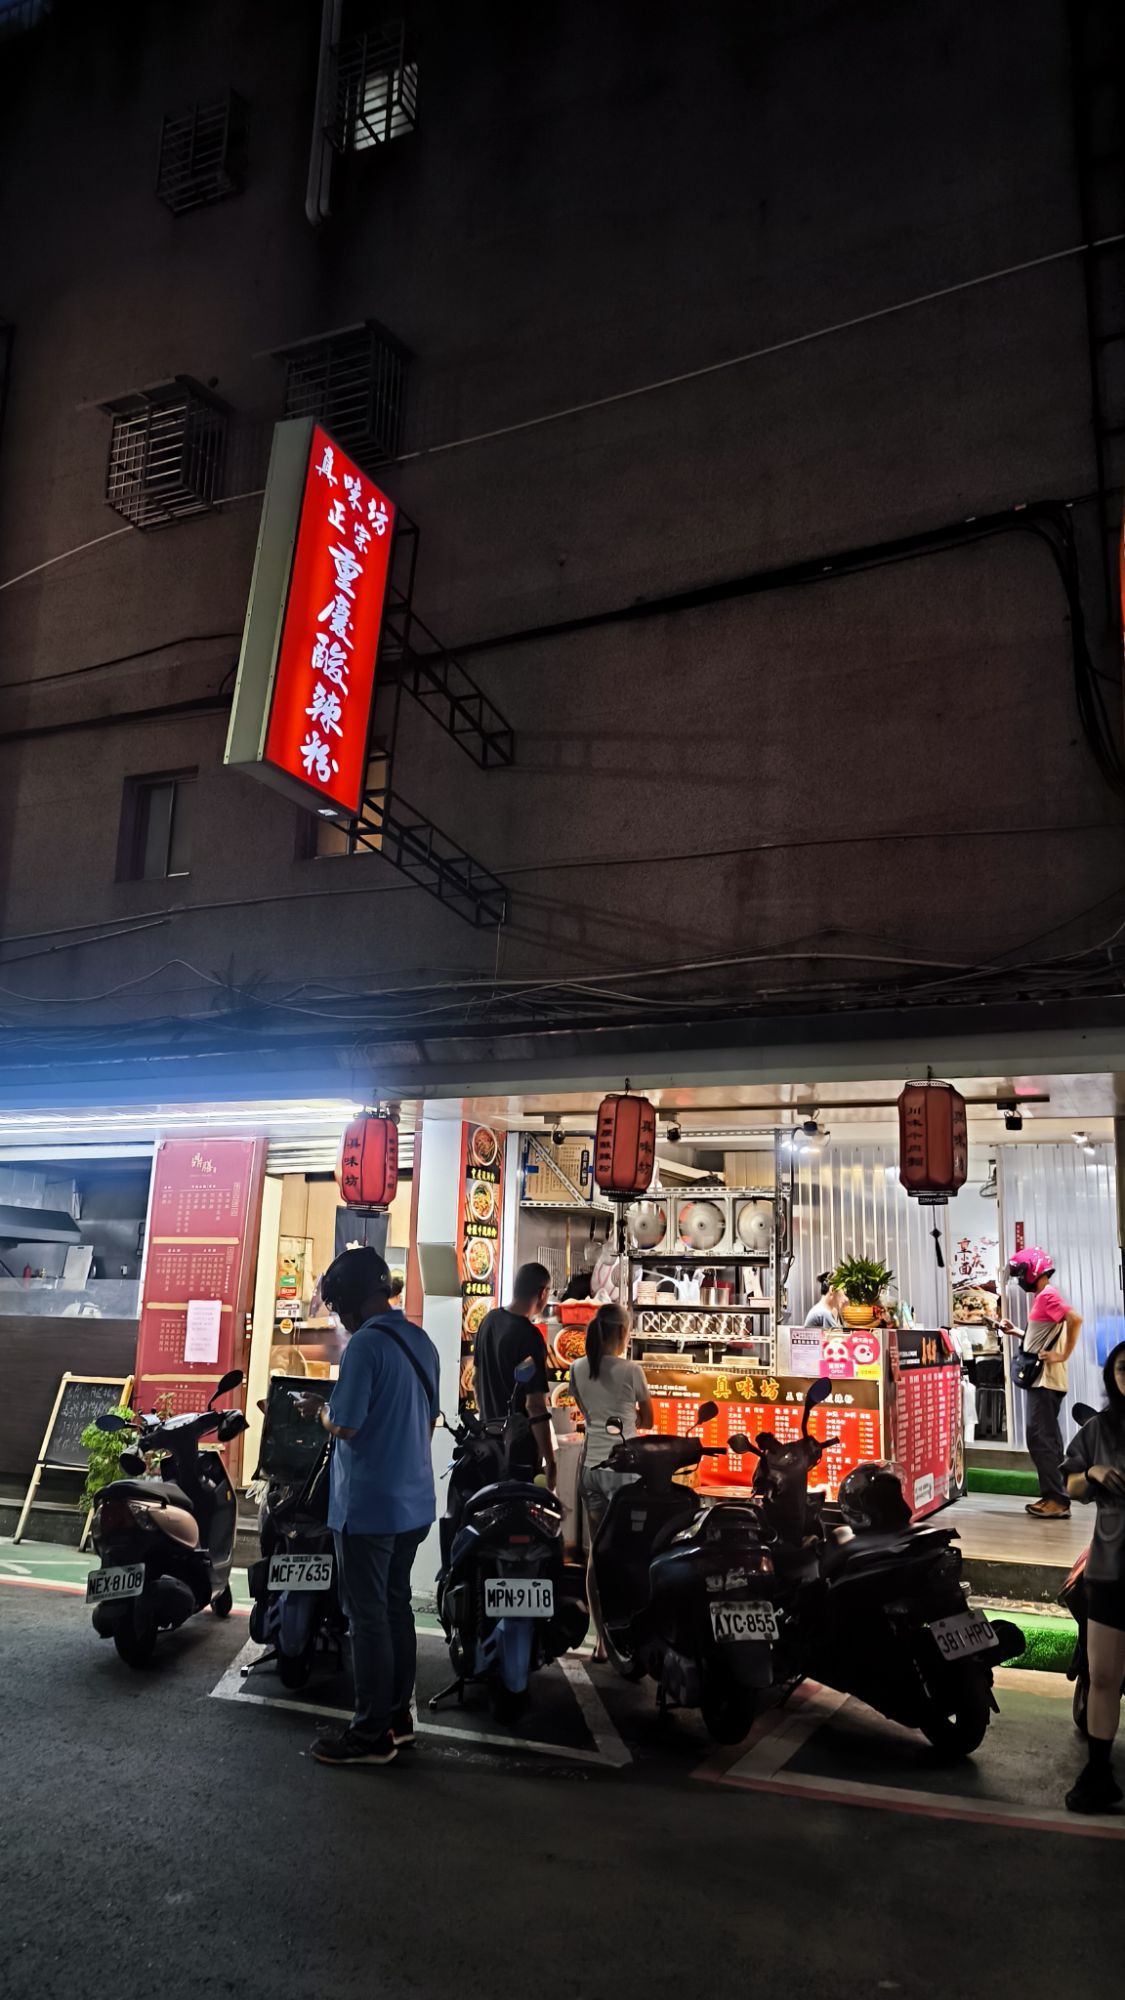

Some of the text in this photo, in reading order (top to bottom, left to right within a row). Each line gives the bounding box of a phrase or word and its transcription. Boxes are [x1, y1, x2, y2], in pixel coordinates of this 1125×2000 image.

[315, 446, 389, 536] 真味坊
[300, 541, 363, 783] 重慶酸辣粉
[638, 1120, 653, 1174] 真味坊
[344, 1138, 361, 1186] 真味坊
[713, 1375, 780, 1400] 真味坊
[87, 1572, 143, 1596] NEX-8108
[271, 1563, 330, 1583] MCF-7635
[487, 1589, 551, 1608] MPN-9118
[714, 1613, 776, 1636] AYC-855
